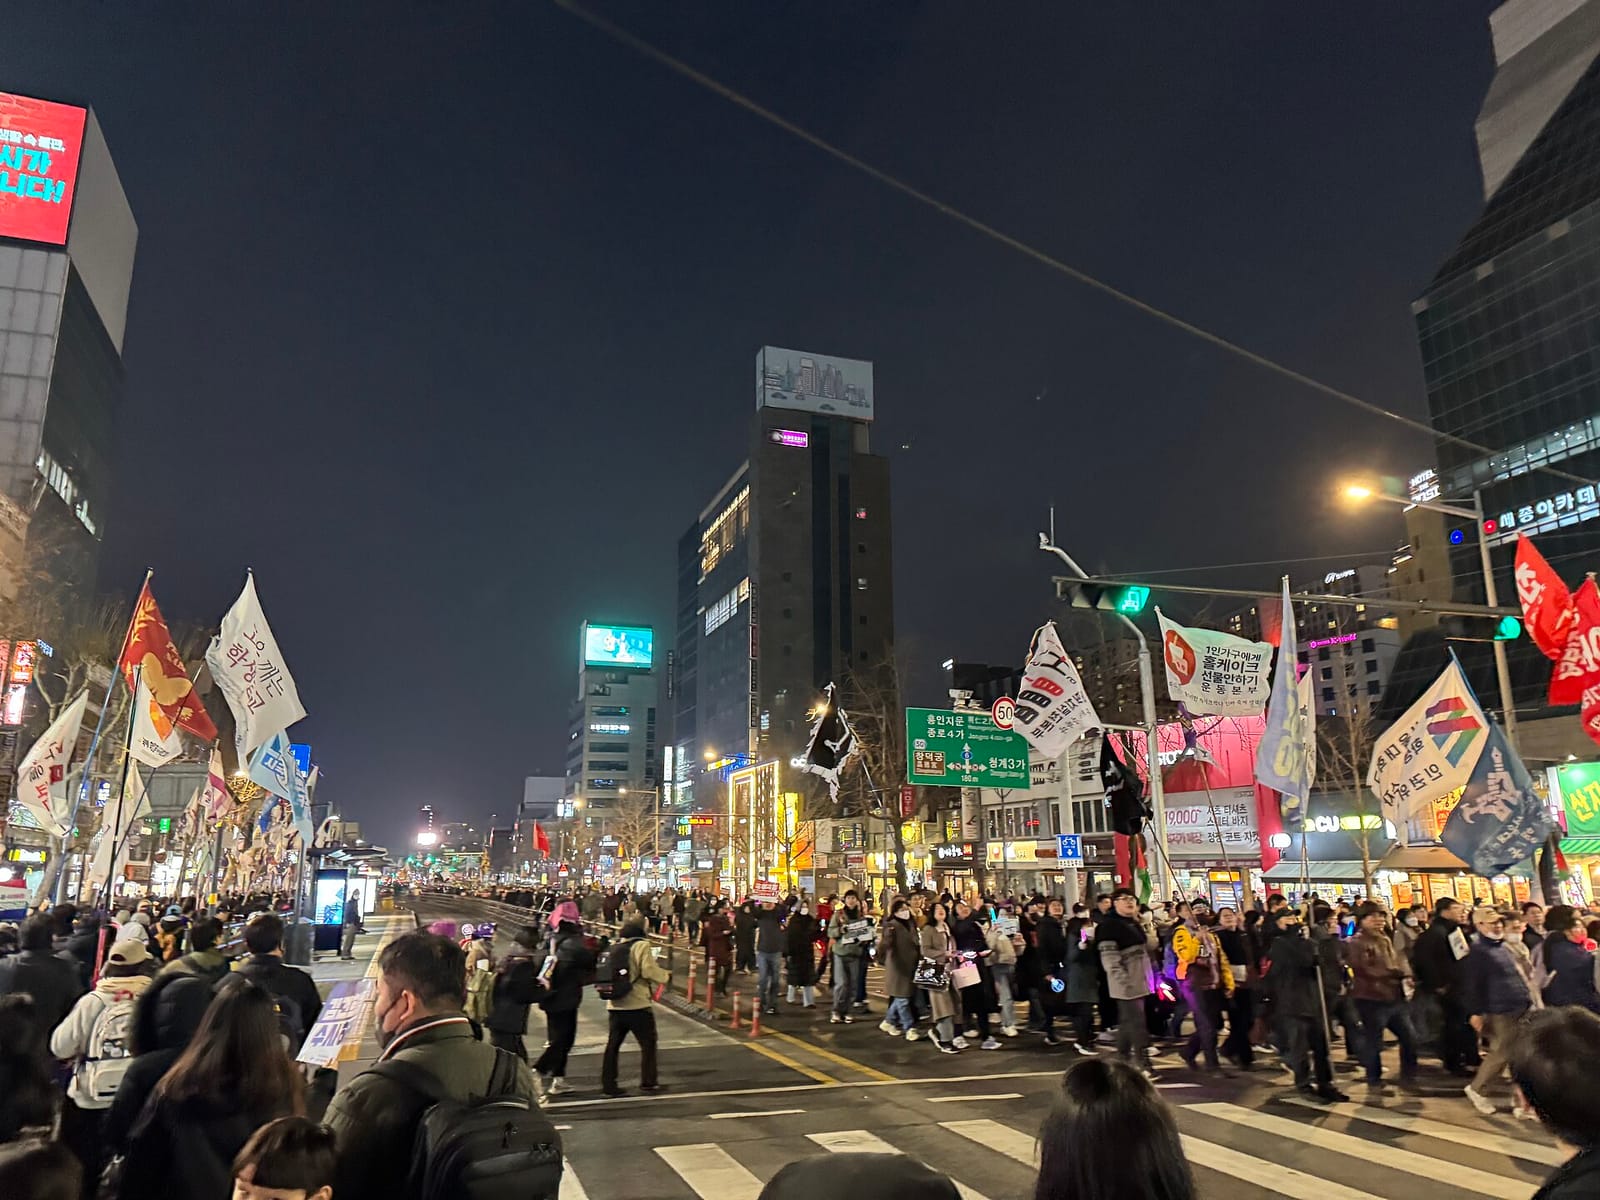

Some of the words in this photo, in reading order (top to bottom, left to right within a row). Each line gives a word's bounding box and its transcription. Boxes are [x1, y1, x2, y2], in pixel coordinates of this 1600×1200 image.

[1499, 482, 1600, 528] 세종아카데
[1205, 646, 1261, 662] 1인가구에게
[1202, 655, 1260, 674] 홀케이크
[1201, 670, 1258, 686] 선물안하기
[998, 706, 1014, 721] 50
[927, 727, 965, 740] 종로4가
[989, 757, 1026, 770] 청계3가
[1315, 815, 1340, 833] CU
